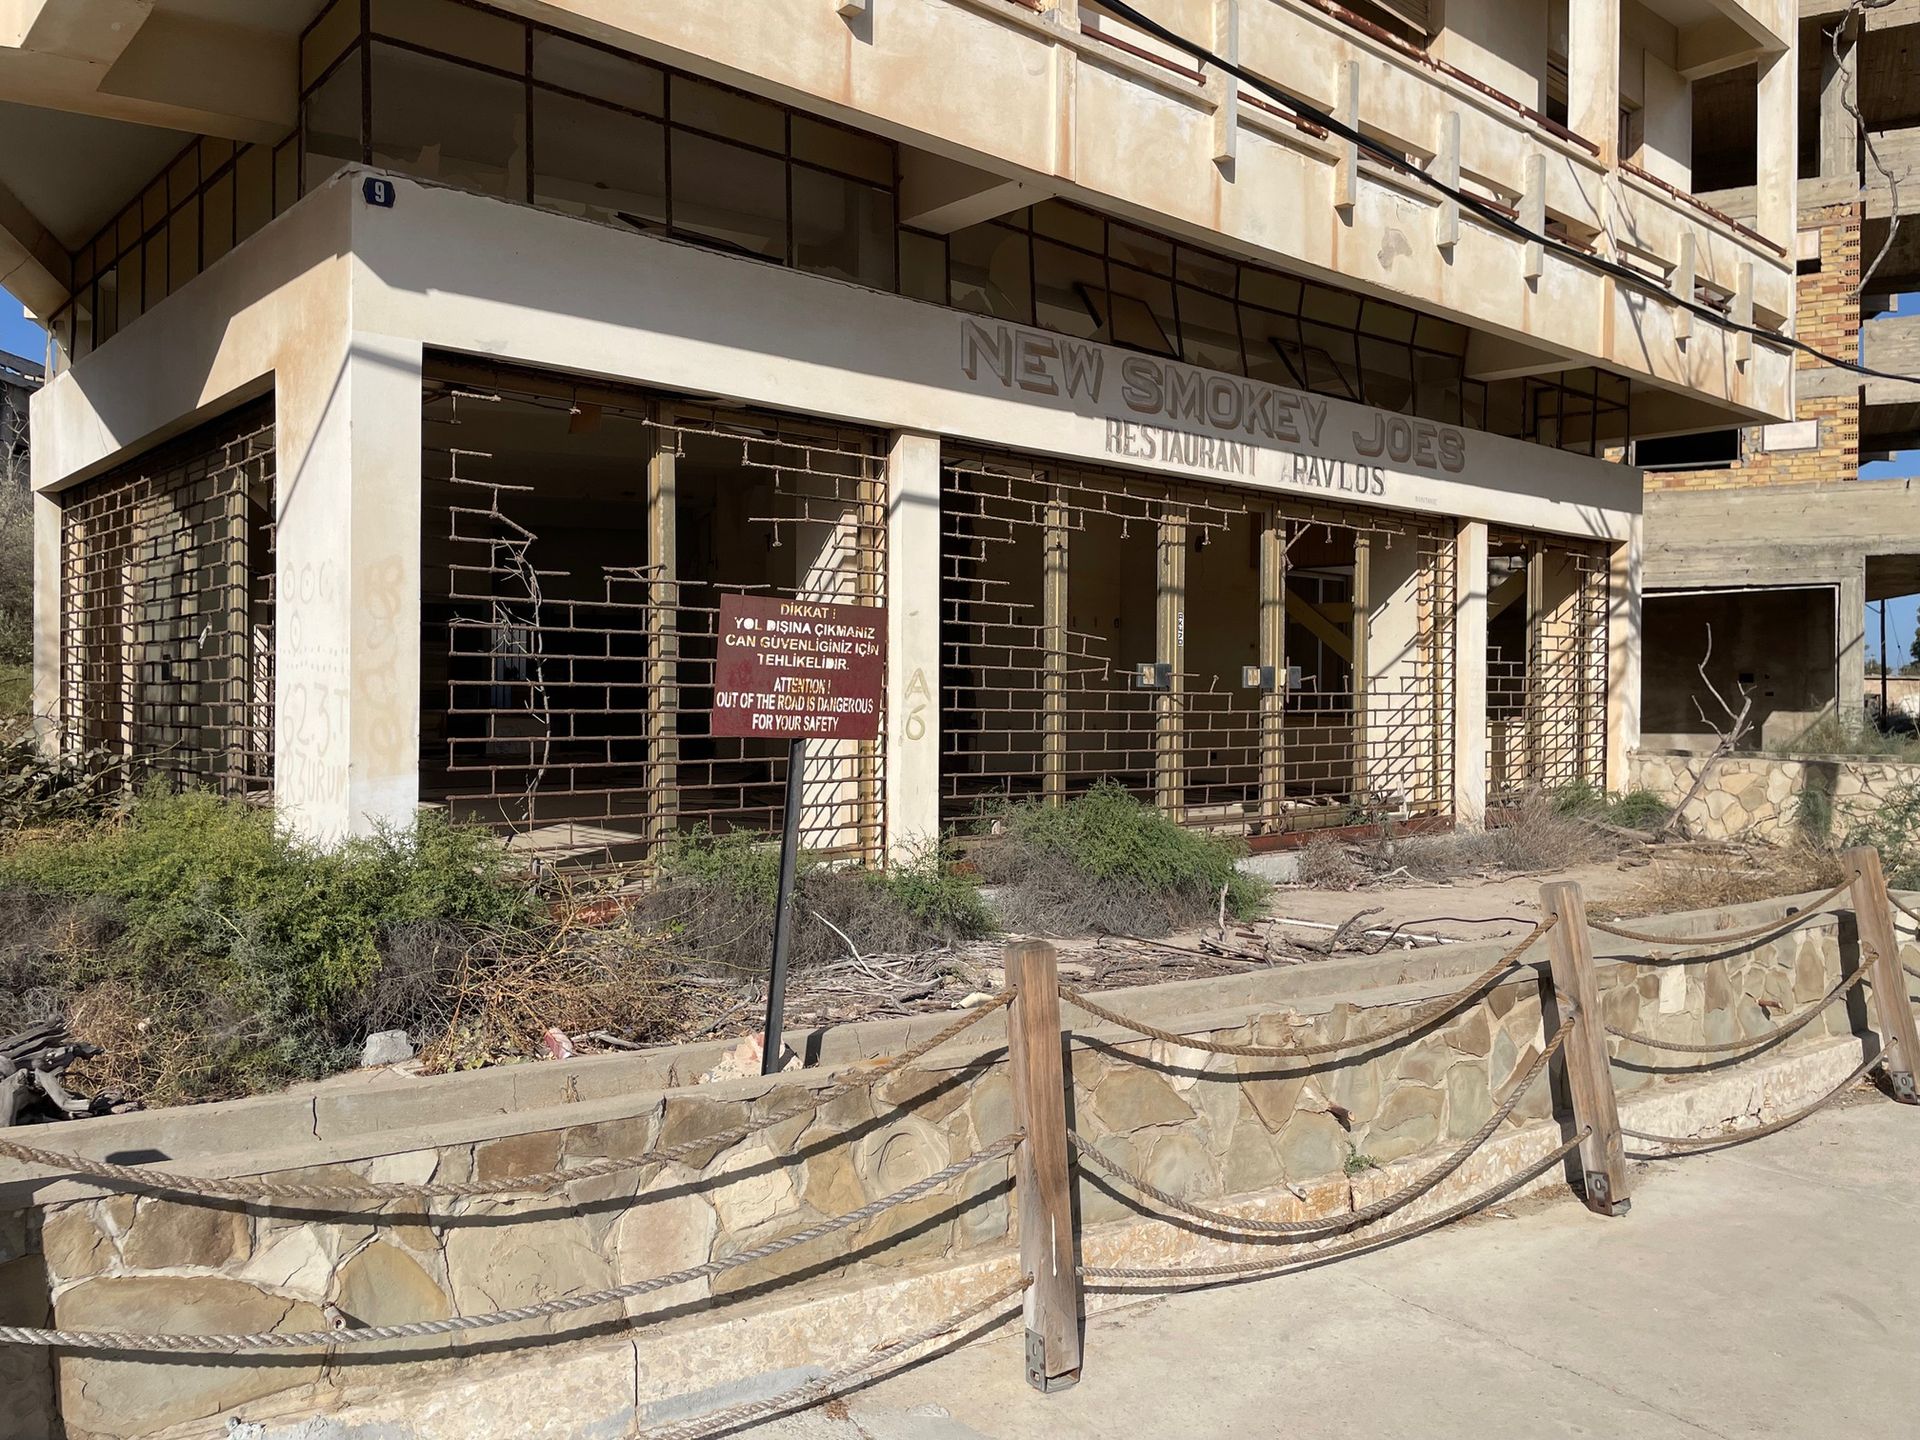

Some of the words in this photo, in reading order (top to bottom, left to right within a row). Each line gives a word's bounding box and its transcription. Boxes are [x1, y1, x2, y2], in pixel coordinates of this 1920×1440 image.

[374, 181, 385, 203] 9
[960, 317, 1104, 404] NEW
[1121, 355, 1328, 448] SMOKEY
[1351, 412, 1466, 474] JOES
[1105, 415, 1259, 478] RESTAURANT
[734, 616, 763, 631] YOL
[725, 633, 757, 648] CAN
[773, 676, 826, 695] ATTENTION
[716, 691, 738, 708] OUT
[740, 692, 754, 709] OF
[756, 693, 776, 711] THE
[777, 694, 805, 712] ROAD
[806, 695, 816, 712] IS
[817, 696, 874, 715] DANGEROUS
[752, 713, 773, 730] FOR
[775, 714, 802, 732] YOUR
[803, 715, 840, 733] SAFETY
